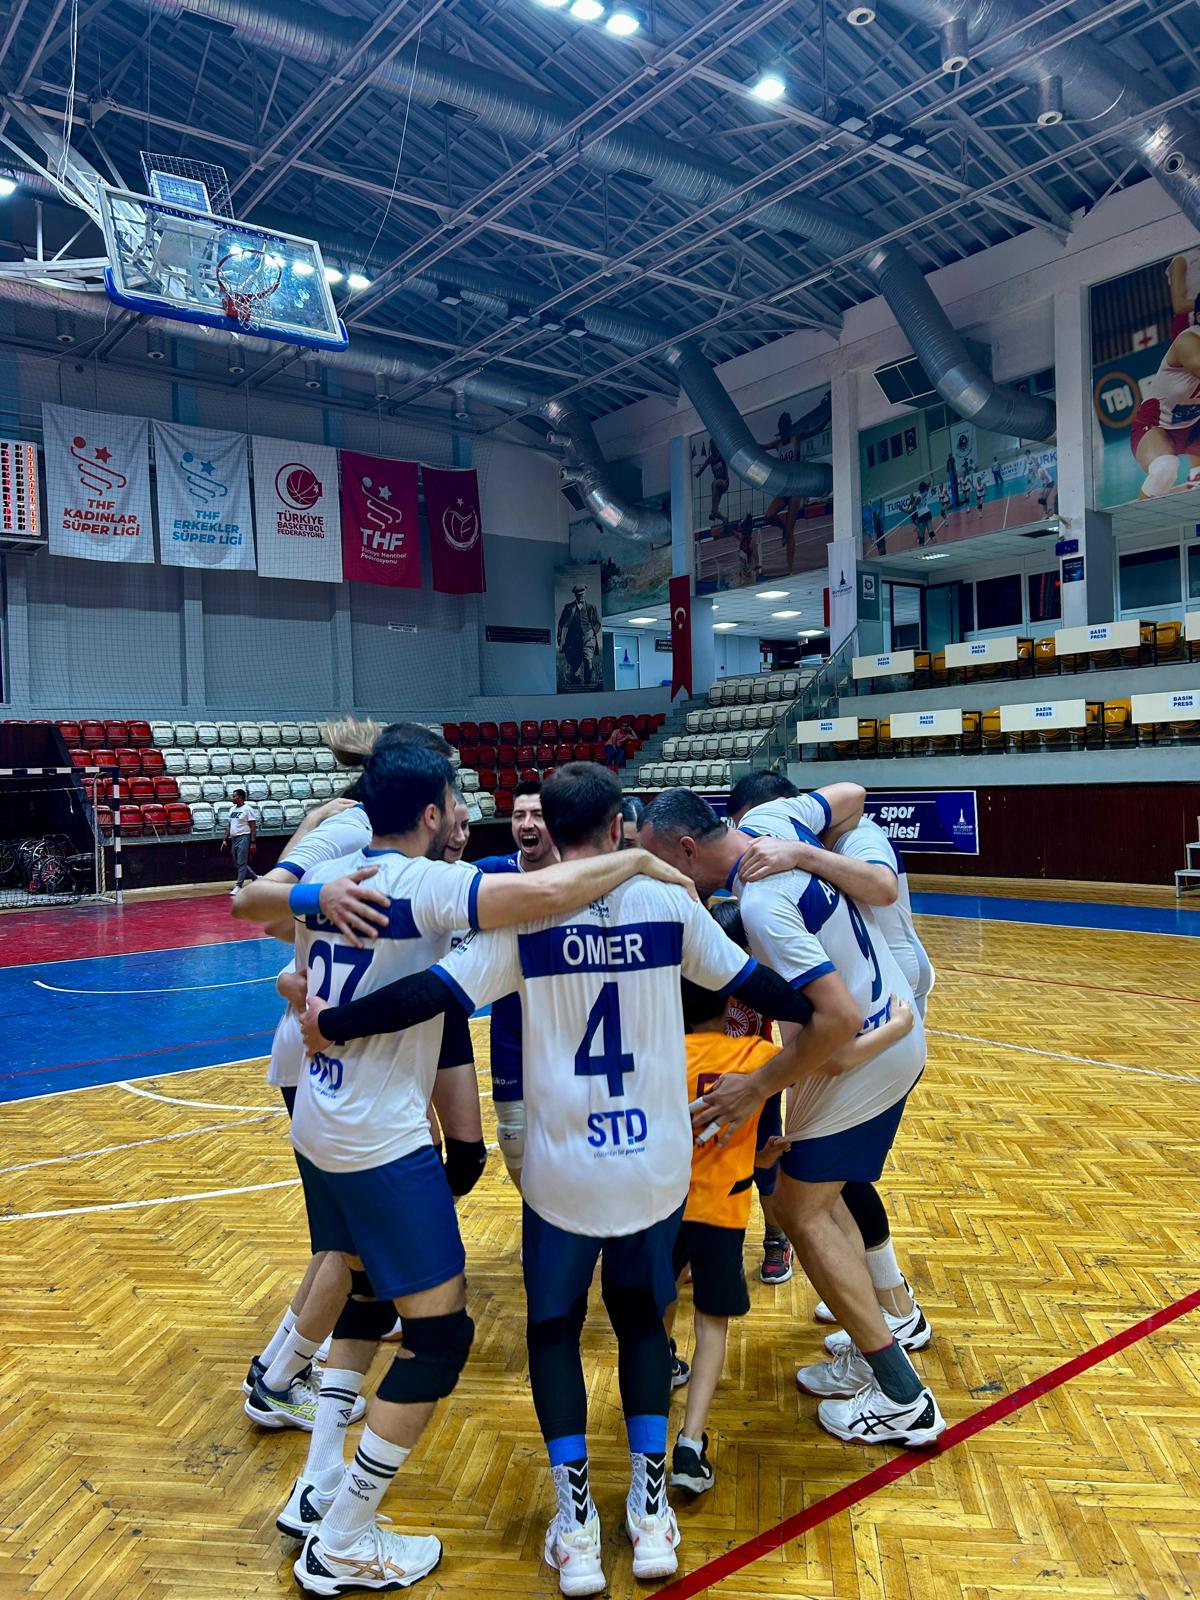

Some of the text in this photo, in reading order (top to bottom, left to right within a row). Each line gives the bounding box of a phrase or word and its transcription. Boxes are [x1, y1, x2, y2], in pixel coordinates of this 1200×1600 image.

[87, 498, 116, 510] THF
[63, 507, 138, 524] KADINLAR
[195, 509, 221, 520] THF
[276, 509, 325, 526] TÜRKİYE
[62, 519, 140, 536] SÜPER LİGİ
[173, 519, 240, 534] ERKEKLER
[277, 521, 325, 533] BASKETBOL
[277, 528, 325, 539] FEDERASYONU
[172, 529, 243, 545] SÜPER LİGİ
[360, 526, 405, 551] THF
[880, 806, 915, 821] spor
[562, 927, 646, 966] ÖMER
[308, 939, 375, 1046] 27
[574, 981, 635, 1098] 4
[587, 1107, 648, 1148] STD
[348, 1485, 370, 1501] umbro
